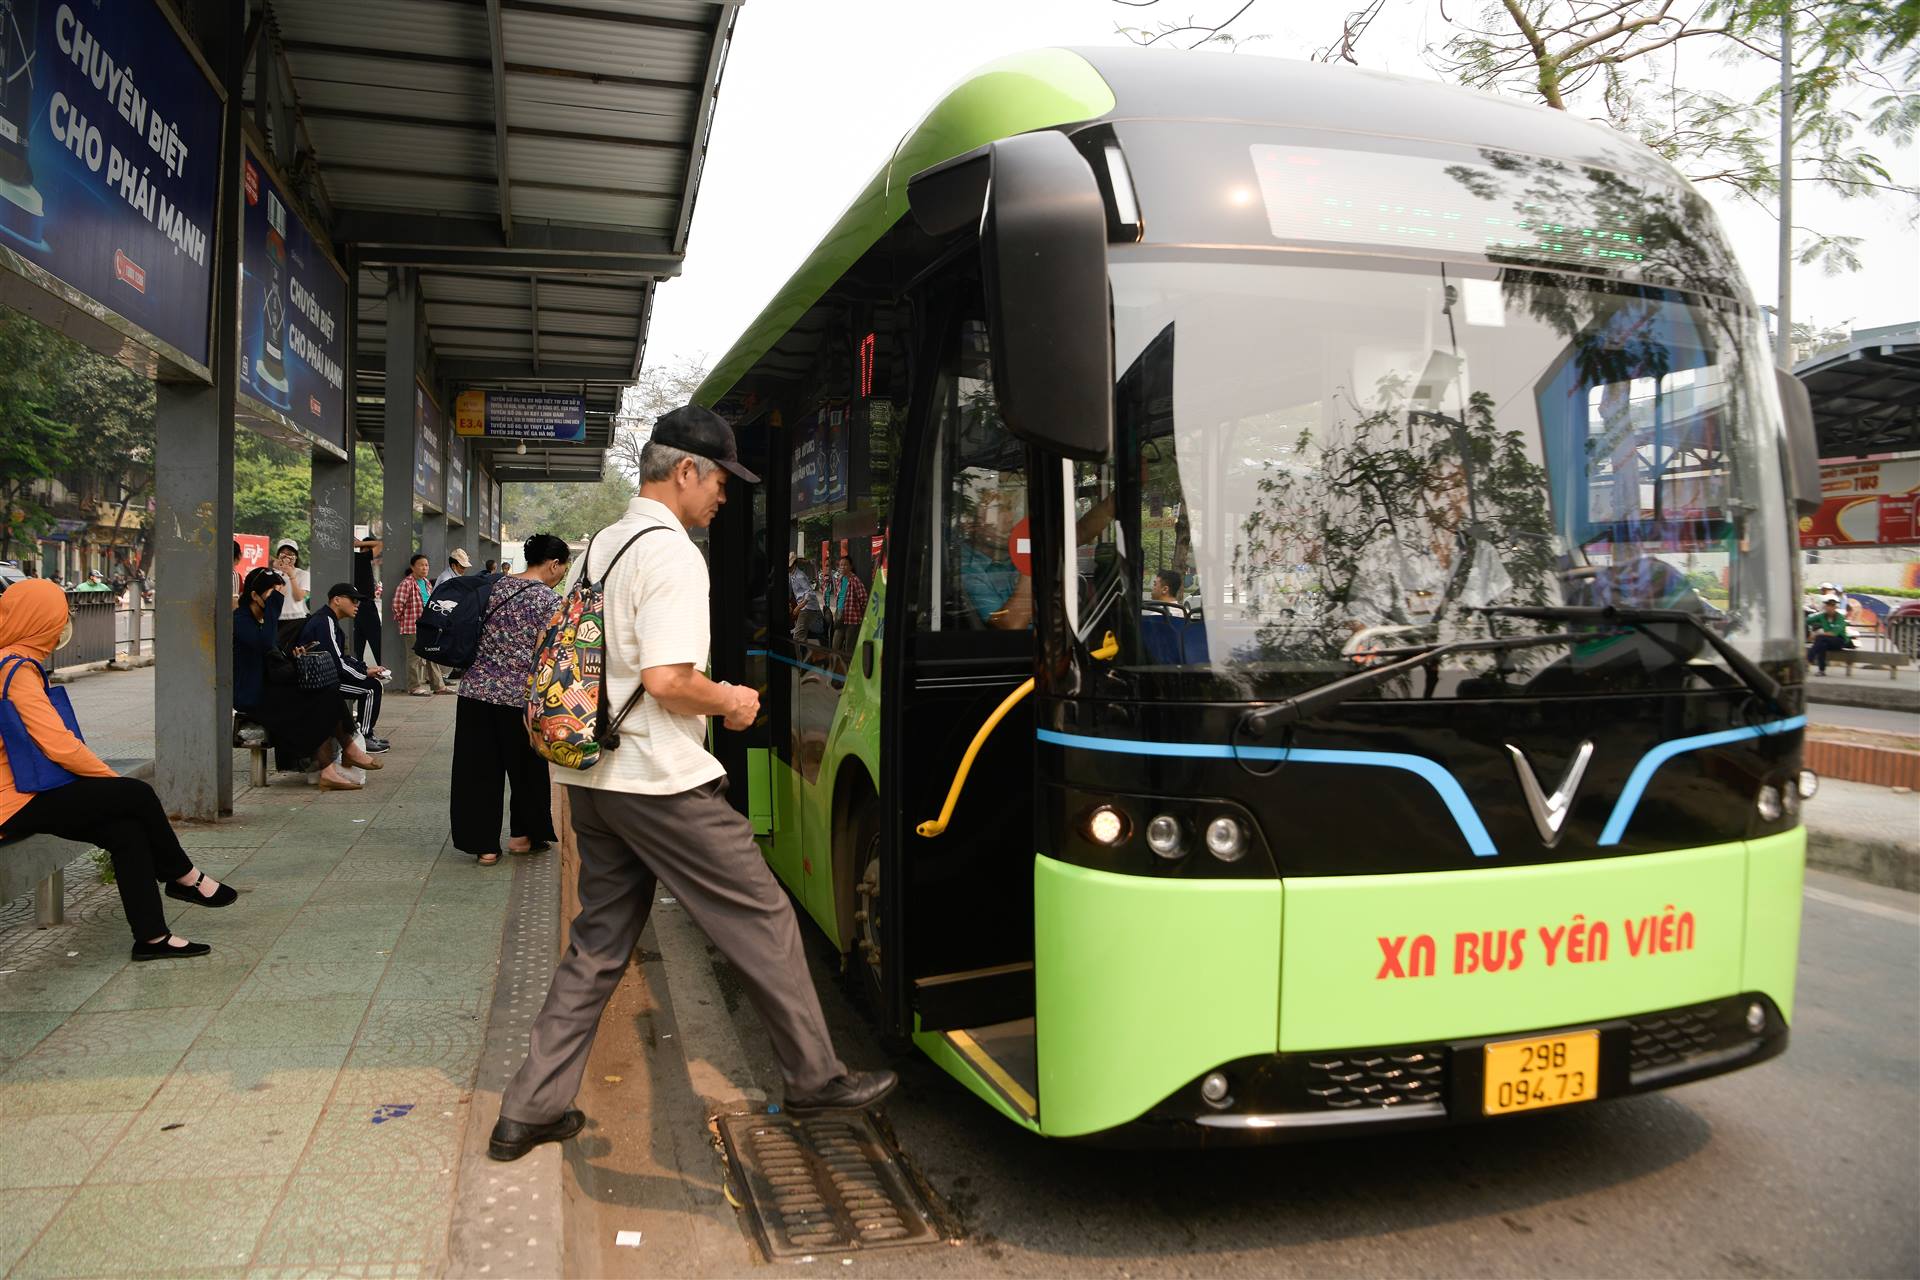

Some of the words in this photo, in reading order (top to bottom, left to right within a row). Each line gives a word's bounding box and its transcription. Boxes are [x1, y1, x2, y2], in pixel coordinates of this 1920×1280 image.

[56, 3, 147, 136] CHUYÊN
[148, 109, 188, 178] BIỆT
[50, 91, 103, 172] CHO
[106, 144, 157, 223] PHÁI
[157, 194, 206, 267] MẠNH
[290, 276, 320, 328] CHUYÊN
[320, 308, 335, 344] BIỆT
[289, 322, 306, 359] CHO
[306, 341, 325, 375] PHÁI
[324, 355, 343, 391] MẠNH
[460, 418, 483, 429] E3.4
[579, 623, 599, 640] NYC
[1376, 934, 1436, 979] XN
[1453, 928, 1527, 975] BUS
[1539, 913, 1609, 967] YÊN
[1624, 904, 1695, 957] VIÊN
[1499, 1071, 1585, 1108] 094.73
[1520, 1042, 1567, 1073] 29B
